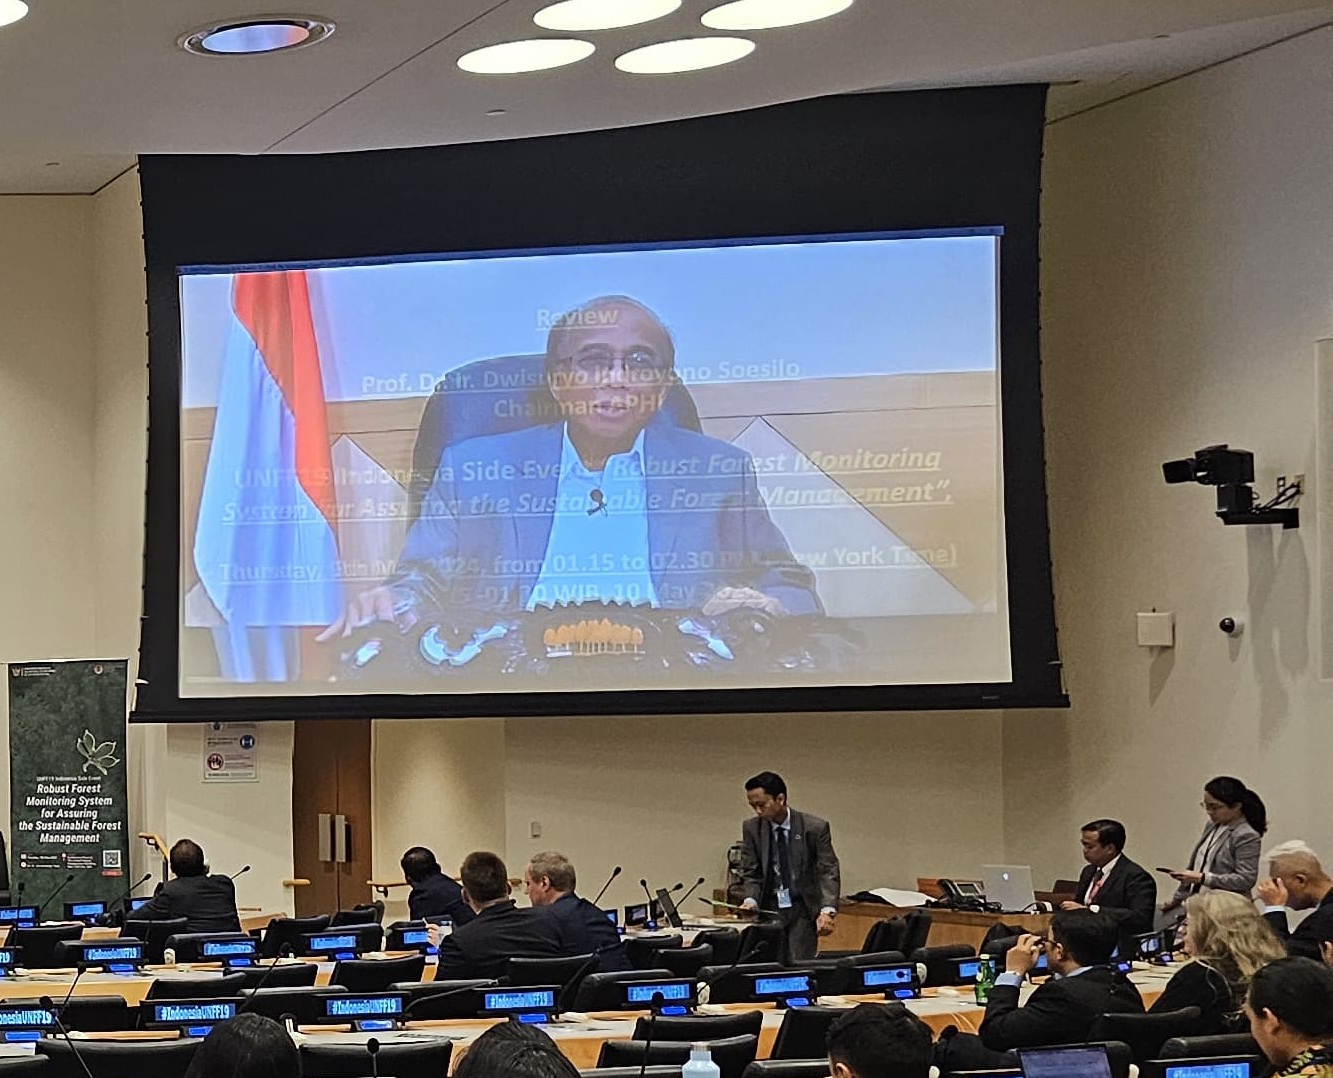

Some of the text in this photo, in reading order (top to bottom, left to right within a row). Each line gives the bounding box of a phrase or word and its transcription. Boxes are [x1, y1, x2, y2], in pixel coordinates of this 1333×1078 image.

[536, 308, 619, 329] Review
[361, 373, 414, 394] Prof.
[718, 359, 800, 380] Soesilo
[461, 460, 513, 482] Side
[794, 447, 942, 474] Monitoring
[468, 493, 511, 515] the
[516, 487, 660, 514] Sustaable
[553, 553, 615, 574] 01.15
[620, 553, 645, 572] to
[652, 550, 716, 571] 02.30
[832, 546, 886, 566] York
[612, 582, 640, 600] 10
[36, 783, 101, 794] Robust Forest
[25, 796, 113, 808] Monitoring System
[41, 808, 98, 820] for Assuring
[18, 821, 122, 831] the Sustainable Forest
[39, 833, 101, 845] Management
[161, 1004, 230, 1020] #IndonesiaUNFF19
